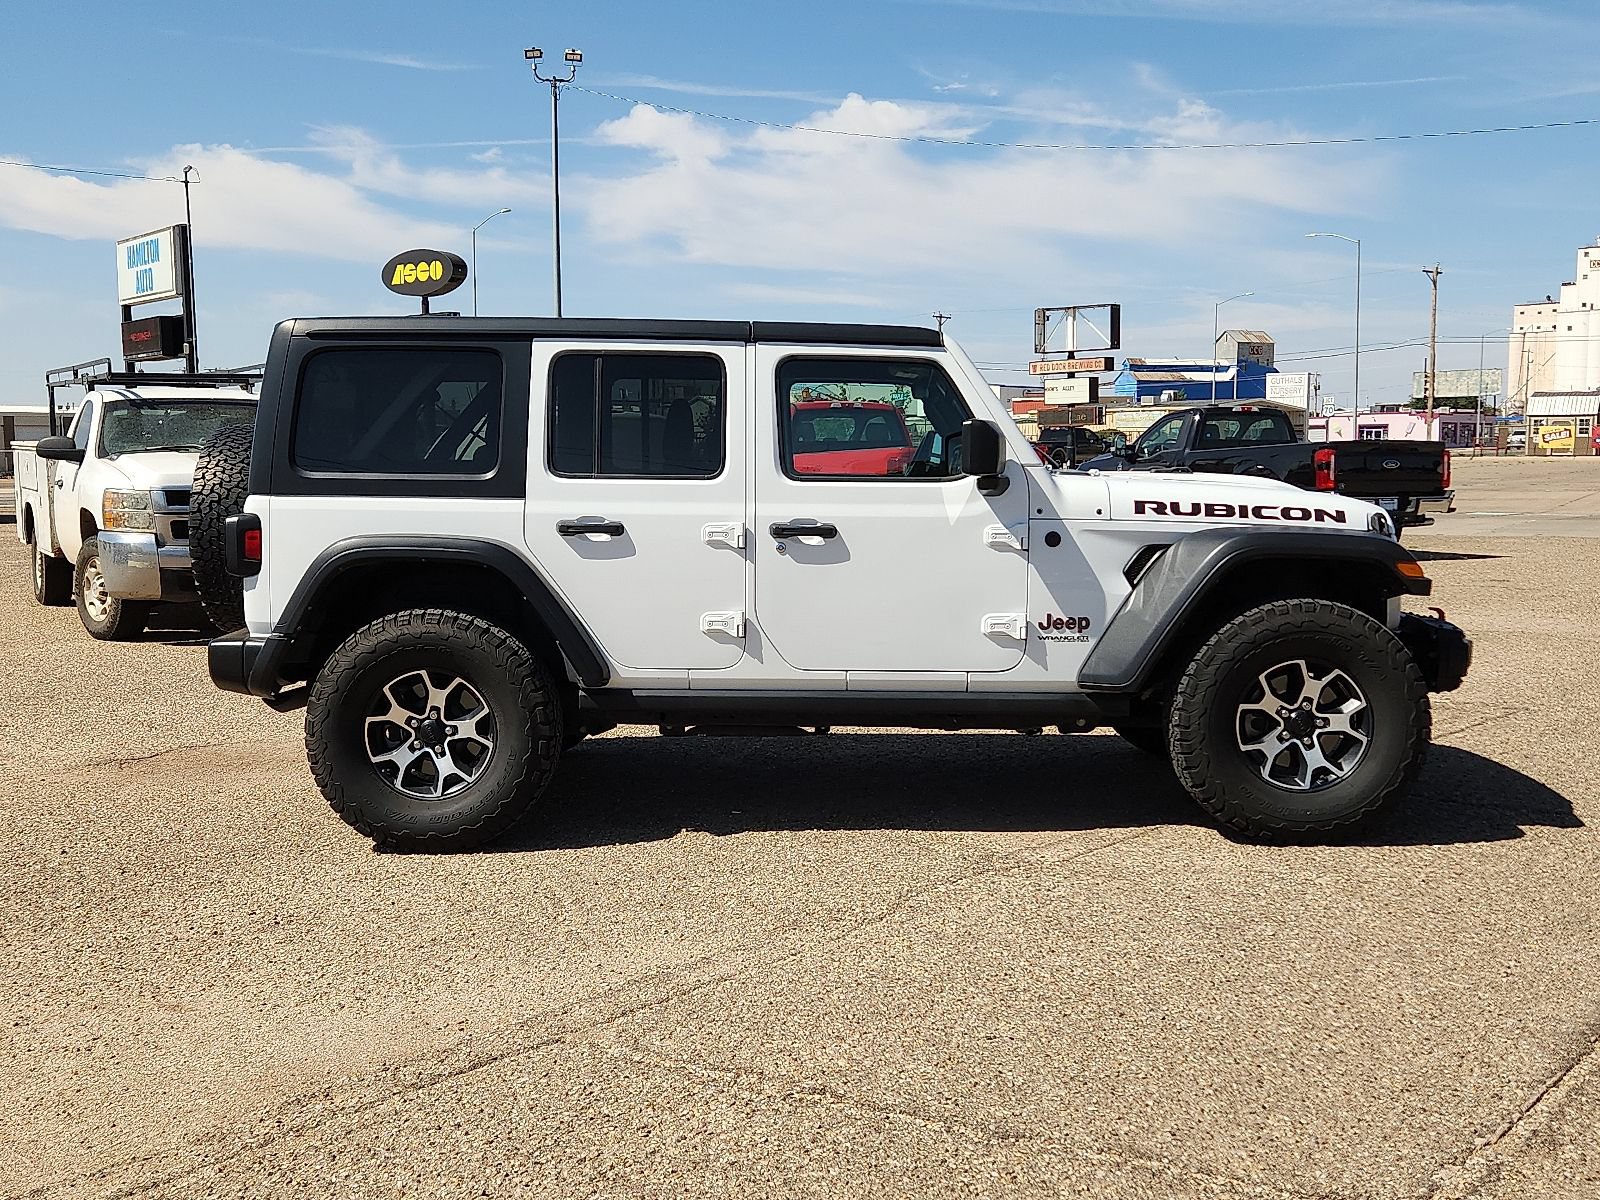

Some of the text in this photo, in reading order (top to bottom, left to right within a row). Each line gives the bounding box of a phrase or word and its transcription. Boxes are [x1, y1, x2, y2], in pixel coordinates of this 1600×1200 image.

[127, 238, 160, 269] HAMILTON
[136, 267, 154, 294] AUTO
[391, 260, 443, 285] ASCO
[1040, 363, 1051, 372] RED
[1270, 376, 1303, 385] GUTHALS
[1270, 387, 1302, 395] NURSERY
[1324, 407, 1334, 415] 70
[1133, 500, 1347, 523] RUBICON
[1038, 613, 1091, 633] Jeep
